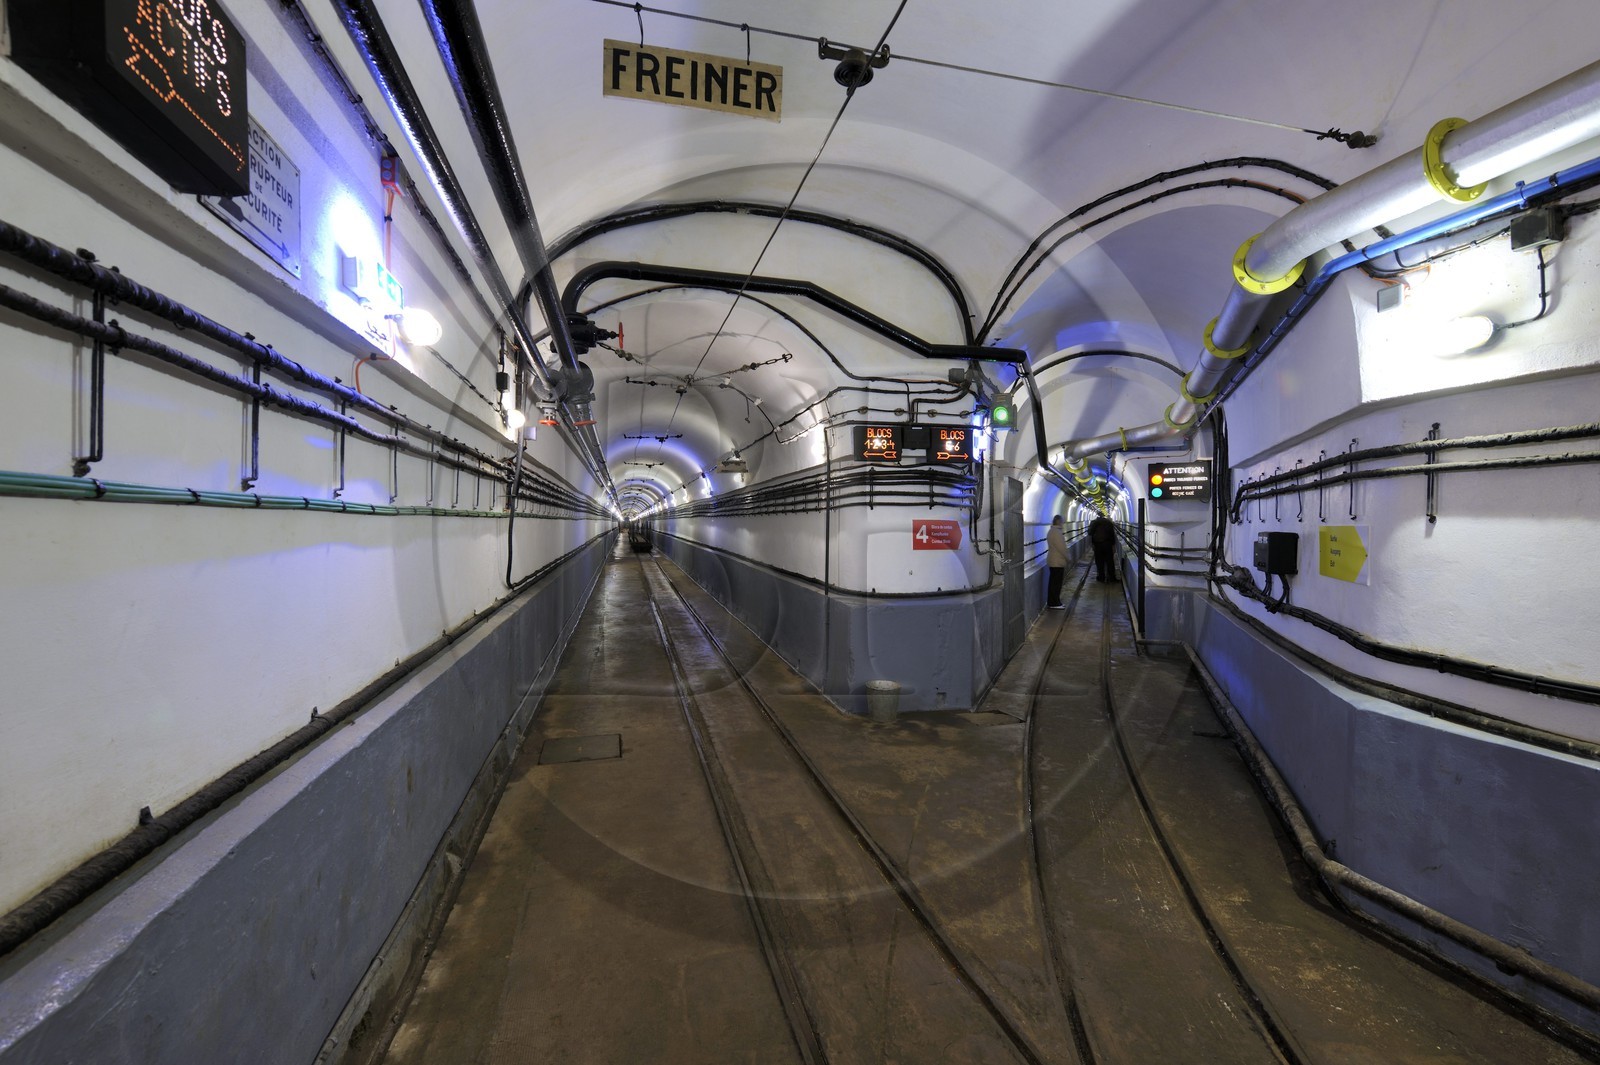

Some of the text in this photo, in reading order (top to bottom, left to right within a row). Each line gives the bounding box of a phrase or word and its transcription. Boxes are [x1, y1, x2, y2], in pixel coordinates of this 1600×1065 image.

[612, 48, 777, 112] FREINER
[255, 181, 264, 194] DE
[867, 428, 893, 438] BLOCS
[940, 430, 965, 440] BLOCS
[1163, 466, 1205, 474] ATTENTION
[916, 524, 929, 544] 4
